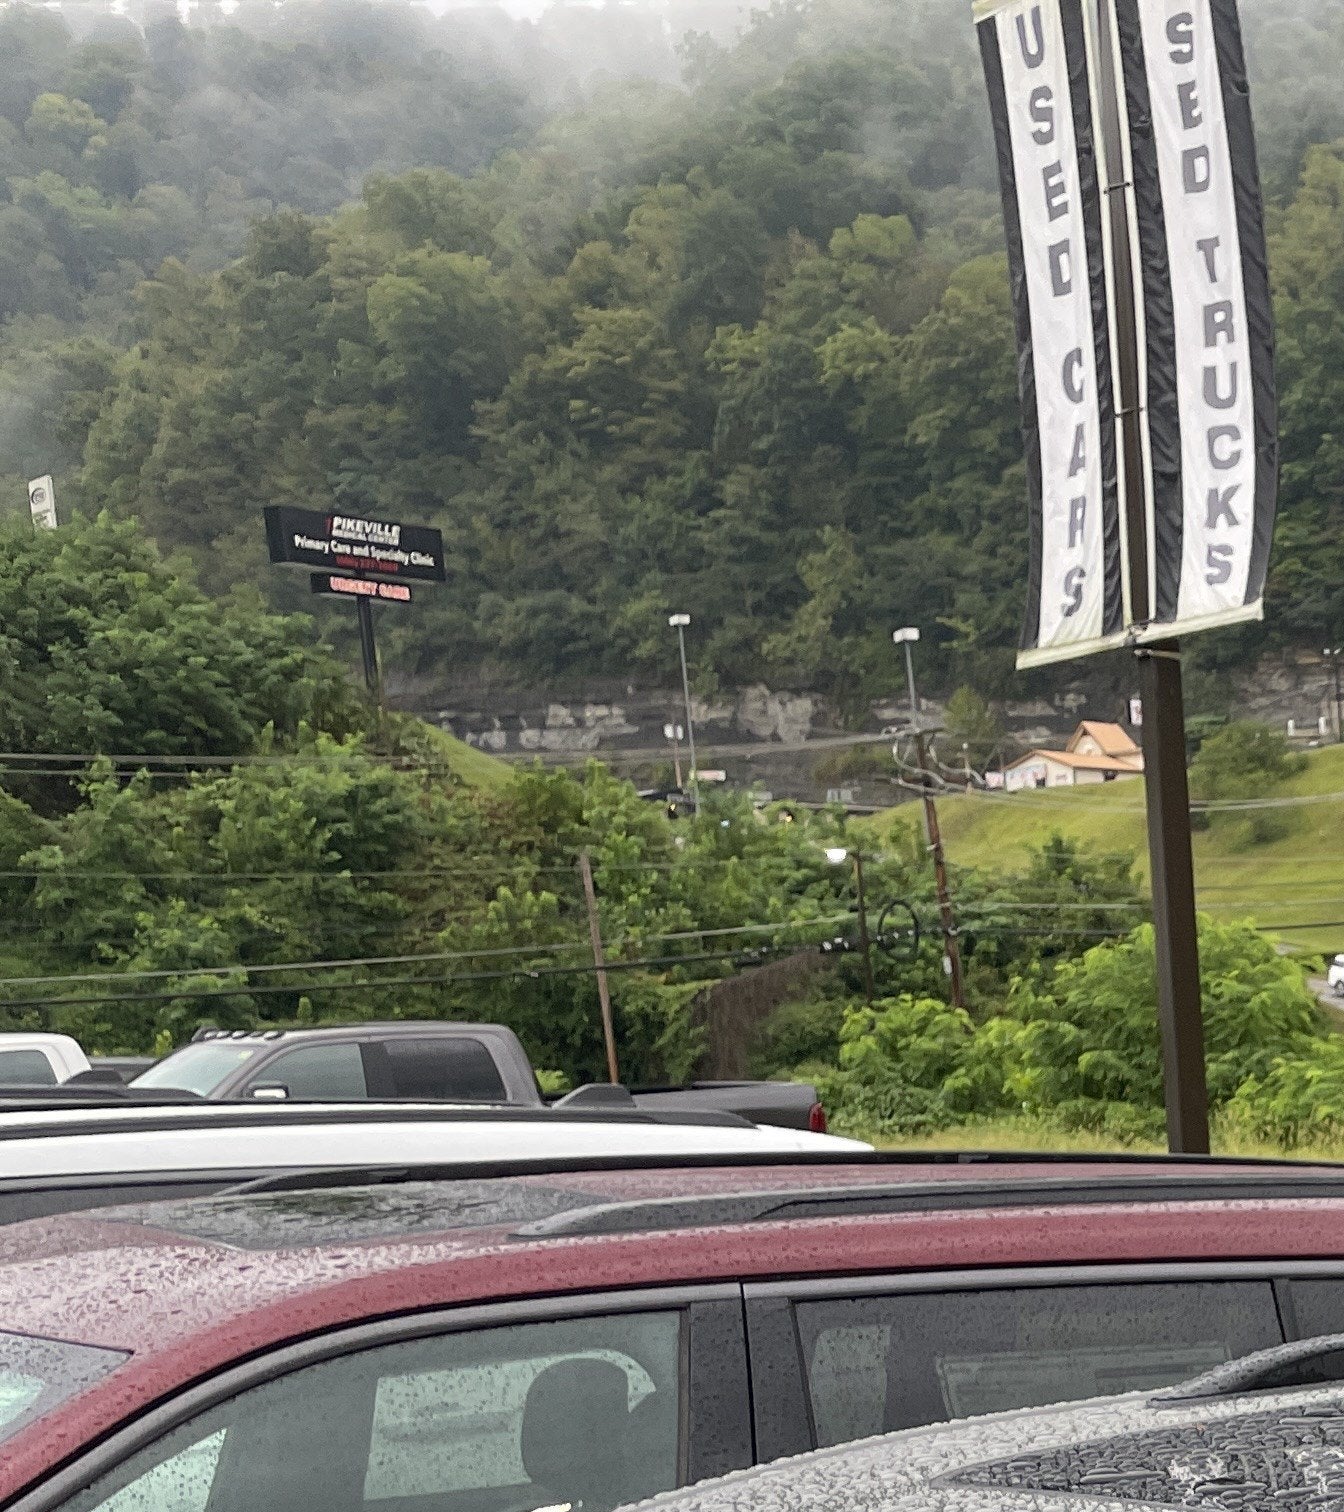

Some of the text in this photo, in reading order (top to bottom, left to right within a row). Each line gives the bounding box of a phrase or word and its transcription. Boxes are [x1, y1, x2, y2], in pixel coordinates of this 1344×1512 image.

[1015, 5, 1085, 618] USED CARS
[1166, 12, 1244, 586] SED TRUCKS
[294, 533, 330, 554] Primary
[330, 539, 351, 555] Care
[353, 544, 369, 557] and
[370, 545, 410, 566] Specialty
[410, 551, 435, 567] Clinic
[332, 515, 401, 537] PIKEVILLE
